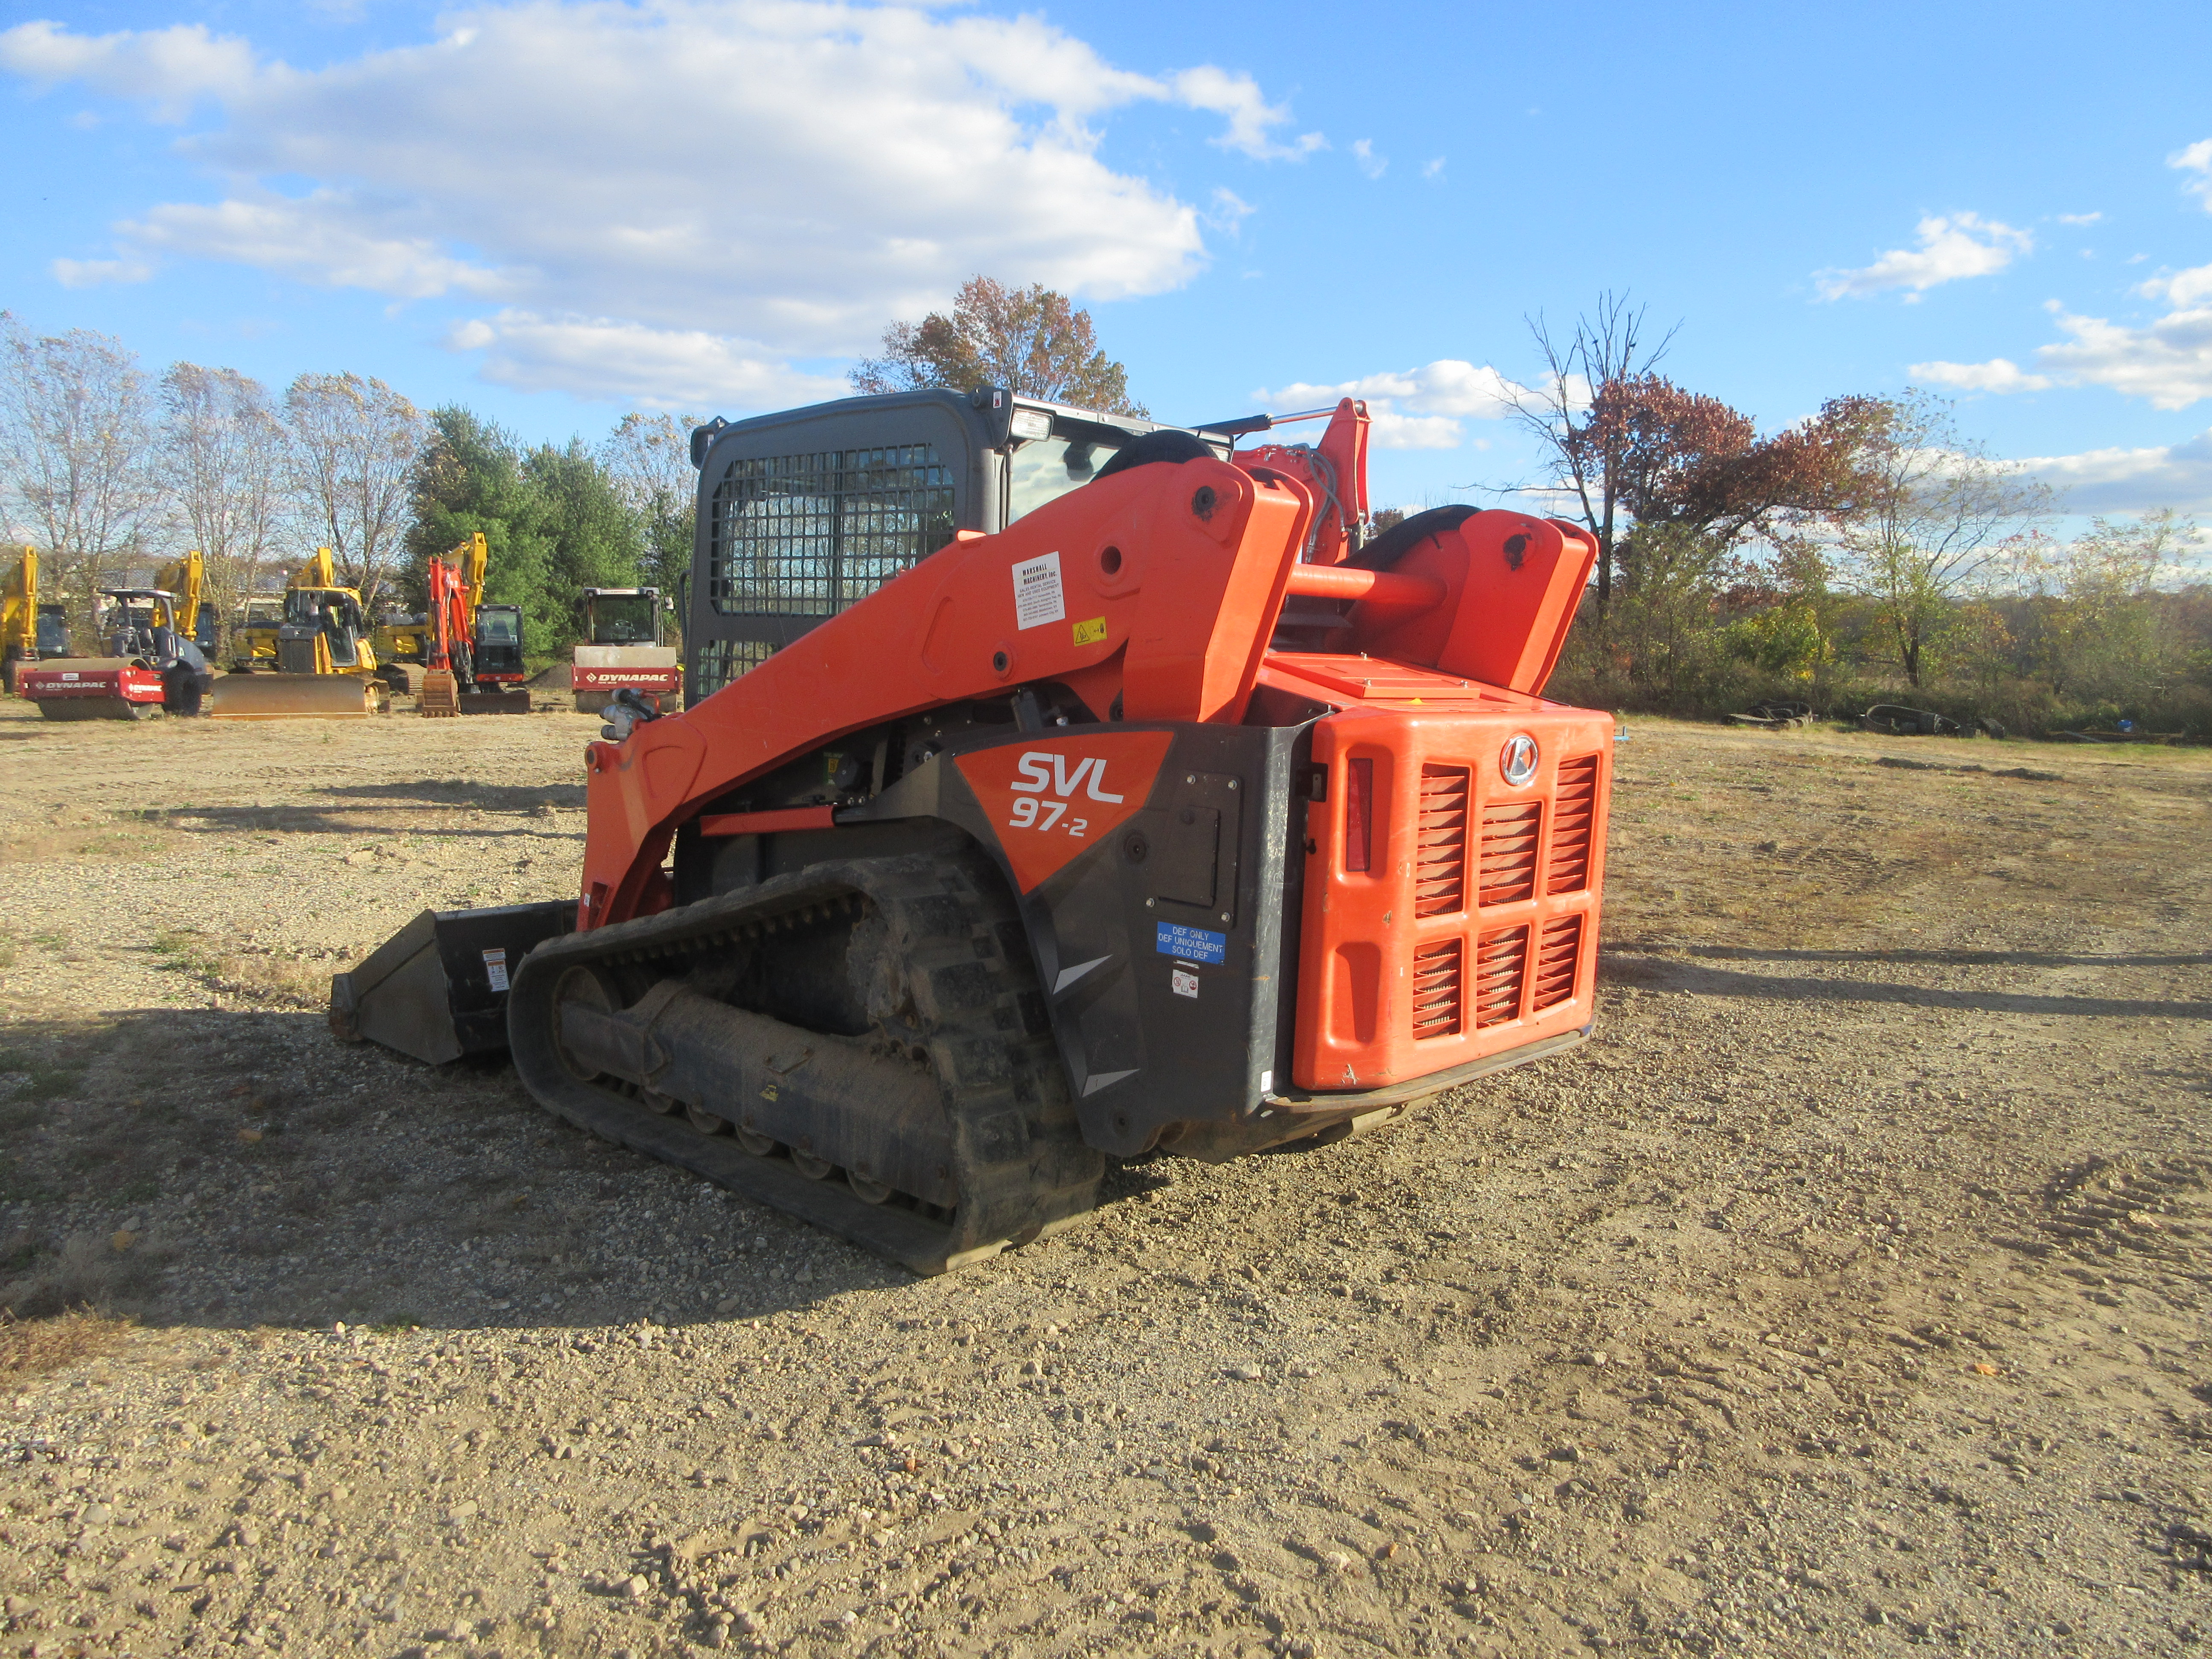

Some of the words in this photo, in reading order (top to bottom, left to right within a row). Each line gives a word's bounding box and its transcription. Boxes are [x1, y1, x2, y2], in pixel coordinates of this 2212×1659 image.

[1022, 564, 1047, 576] MARSHALL
[1010, 751, 1124, 804] SVL
[1009, 797, 1088, 837] 97-2
[1173, 926, 1187, 936] DEF
[1190, 930, 1209, 940] ONLY
[1158, 933, 1173, 943] DEF
[1175, 936, 1223, 953] UNIQUEMENT
[1172, 946, 1191, 956] SOLO
[1194, 950, 1208, 959] DEF
